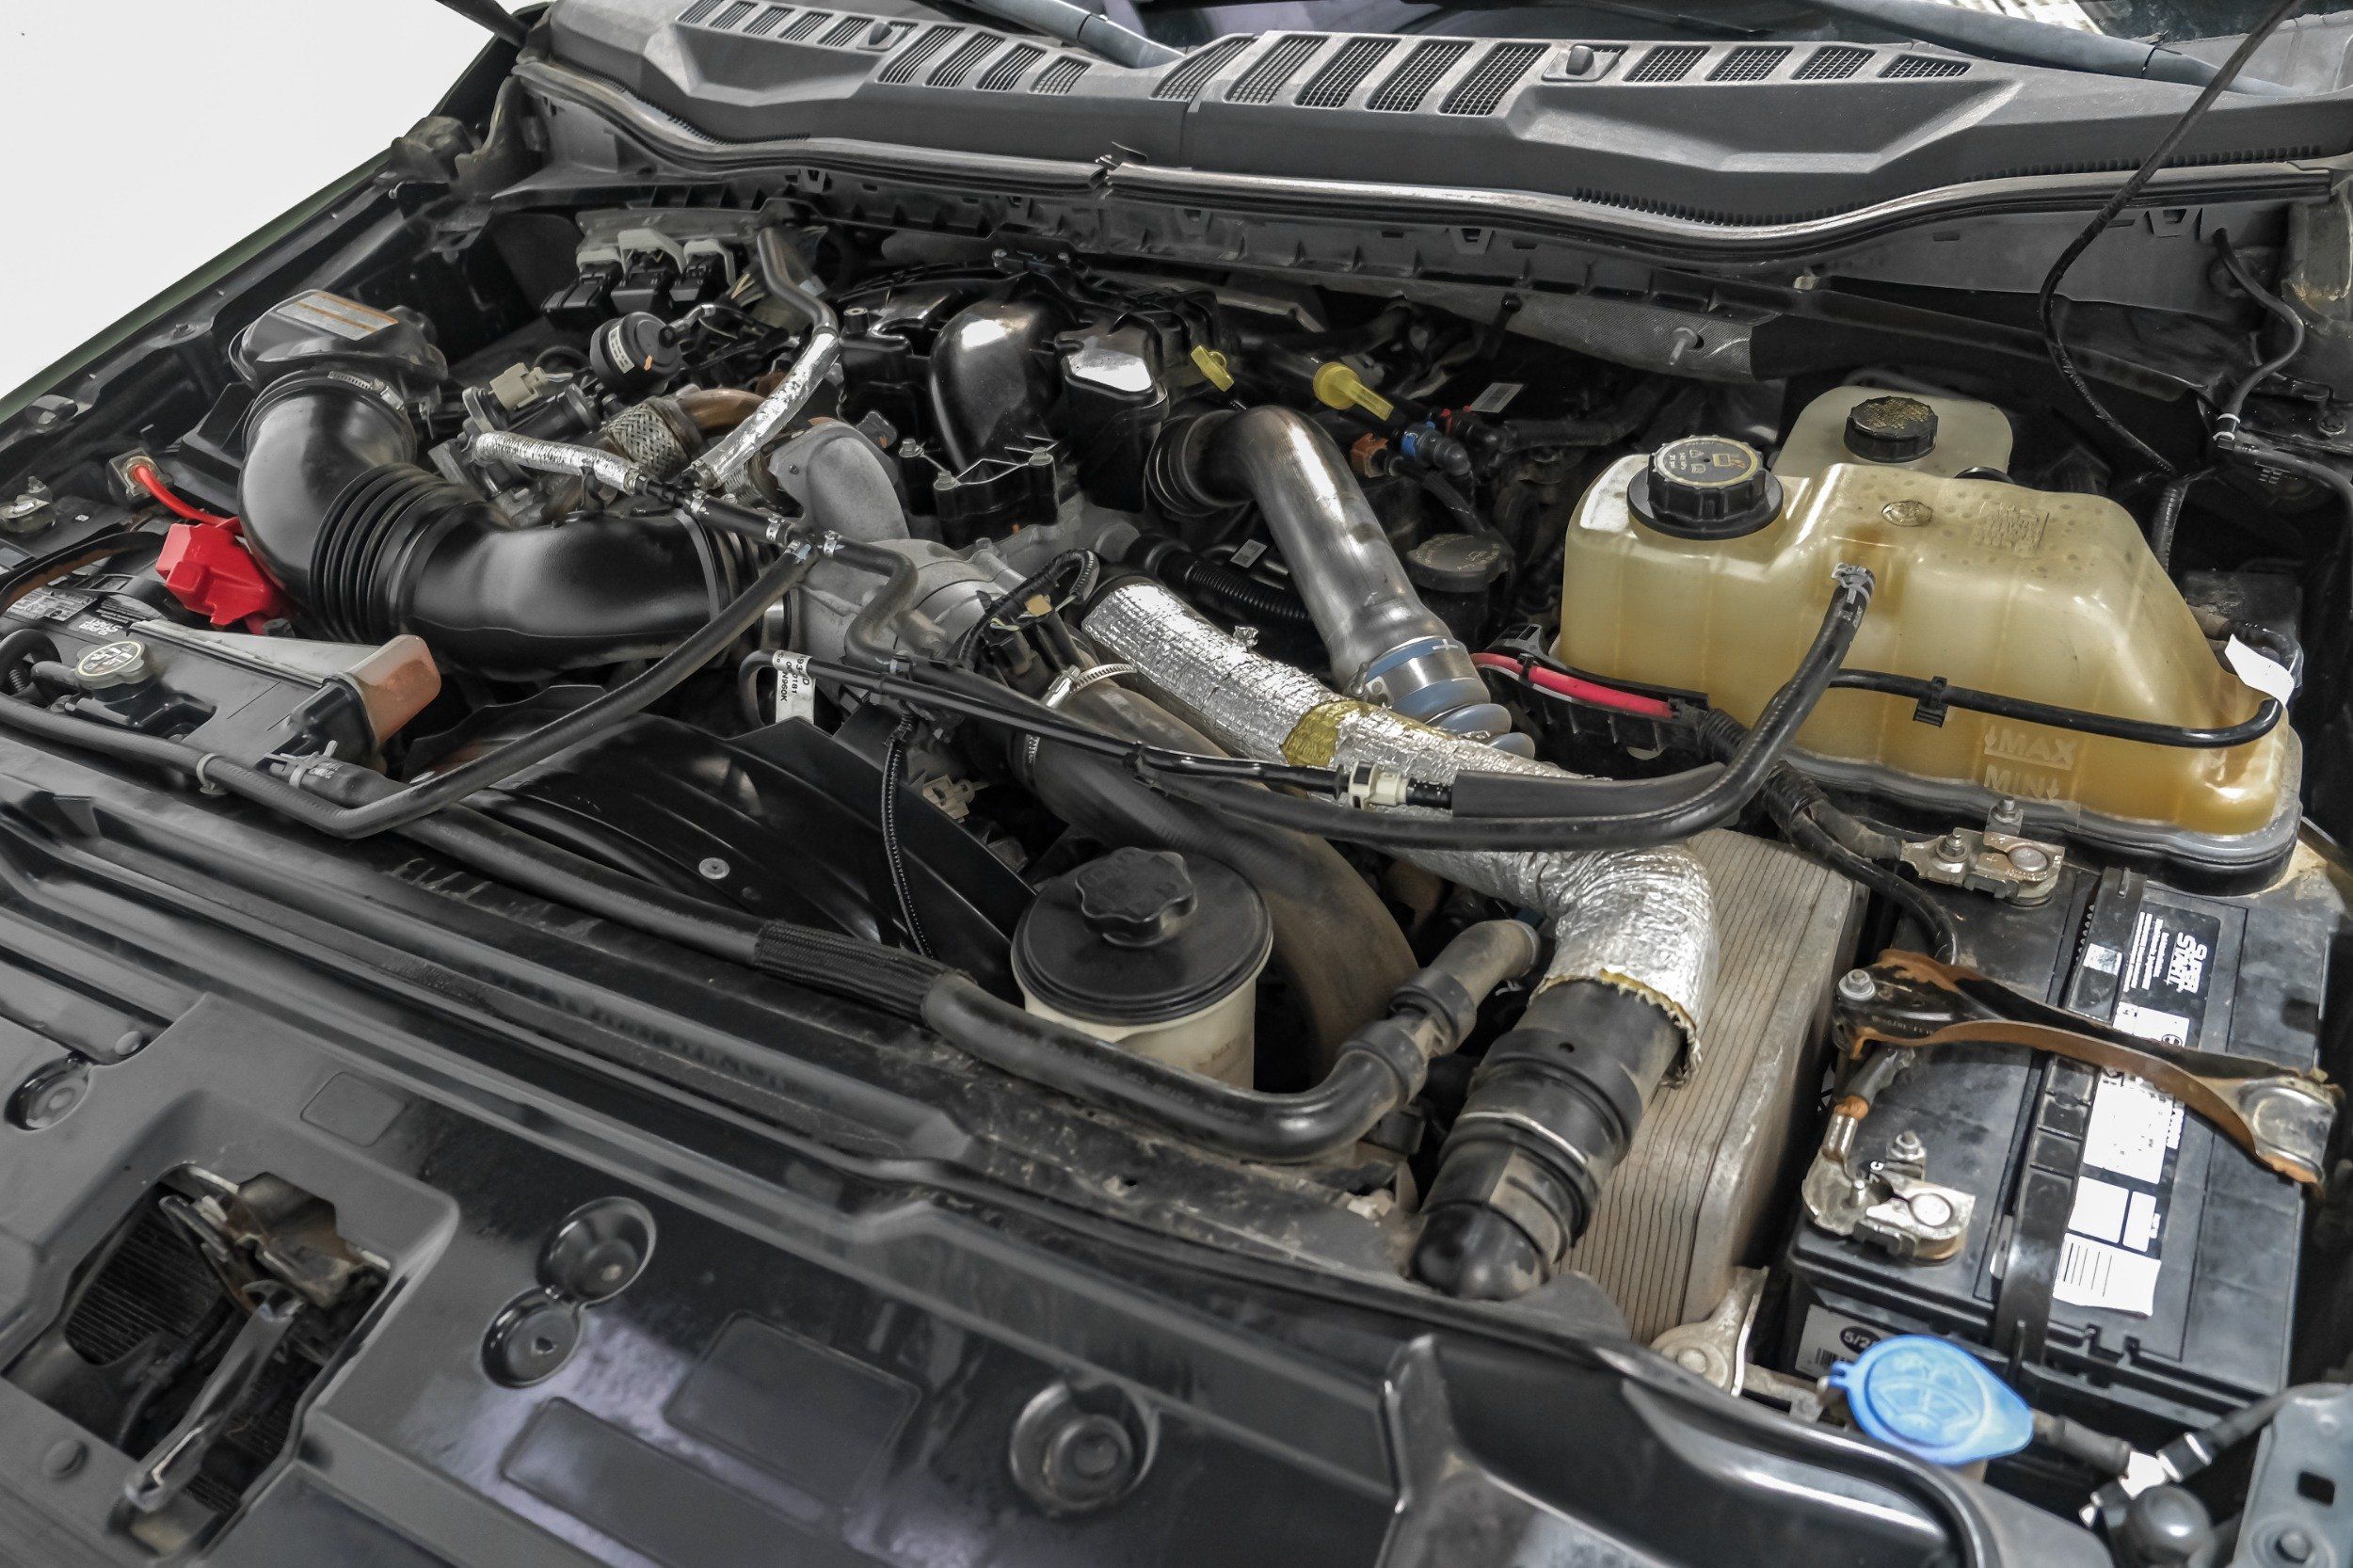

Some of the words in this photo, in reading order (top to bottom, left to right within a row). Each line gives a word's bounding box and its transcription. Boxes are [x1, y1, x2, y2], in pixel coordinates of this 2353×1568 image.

[1998, 728, 2077, 764] MAX
[1983, 764, 2046, 799] MIN
[2169, 932, 2197, 993] START
[2183, 943, 2208, 994] SUPER
